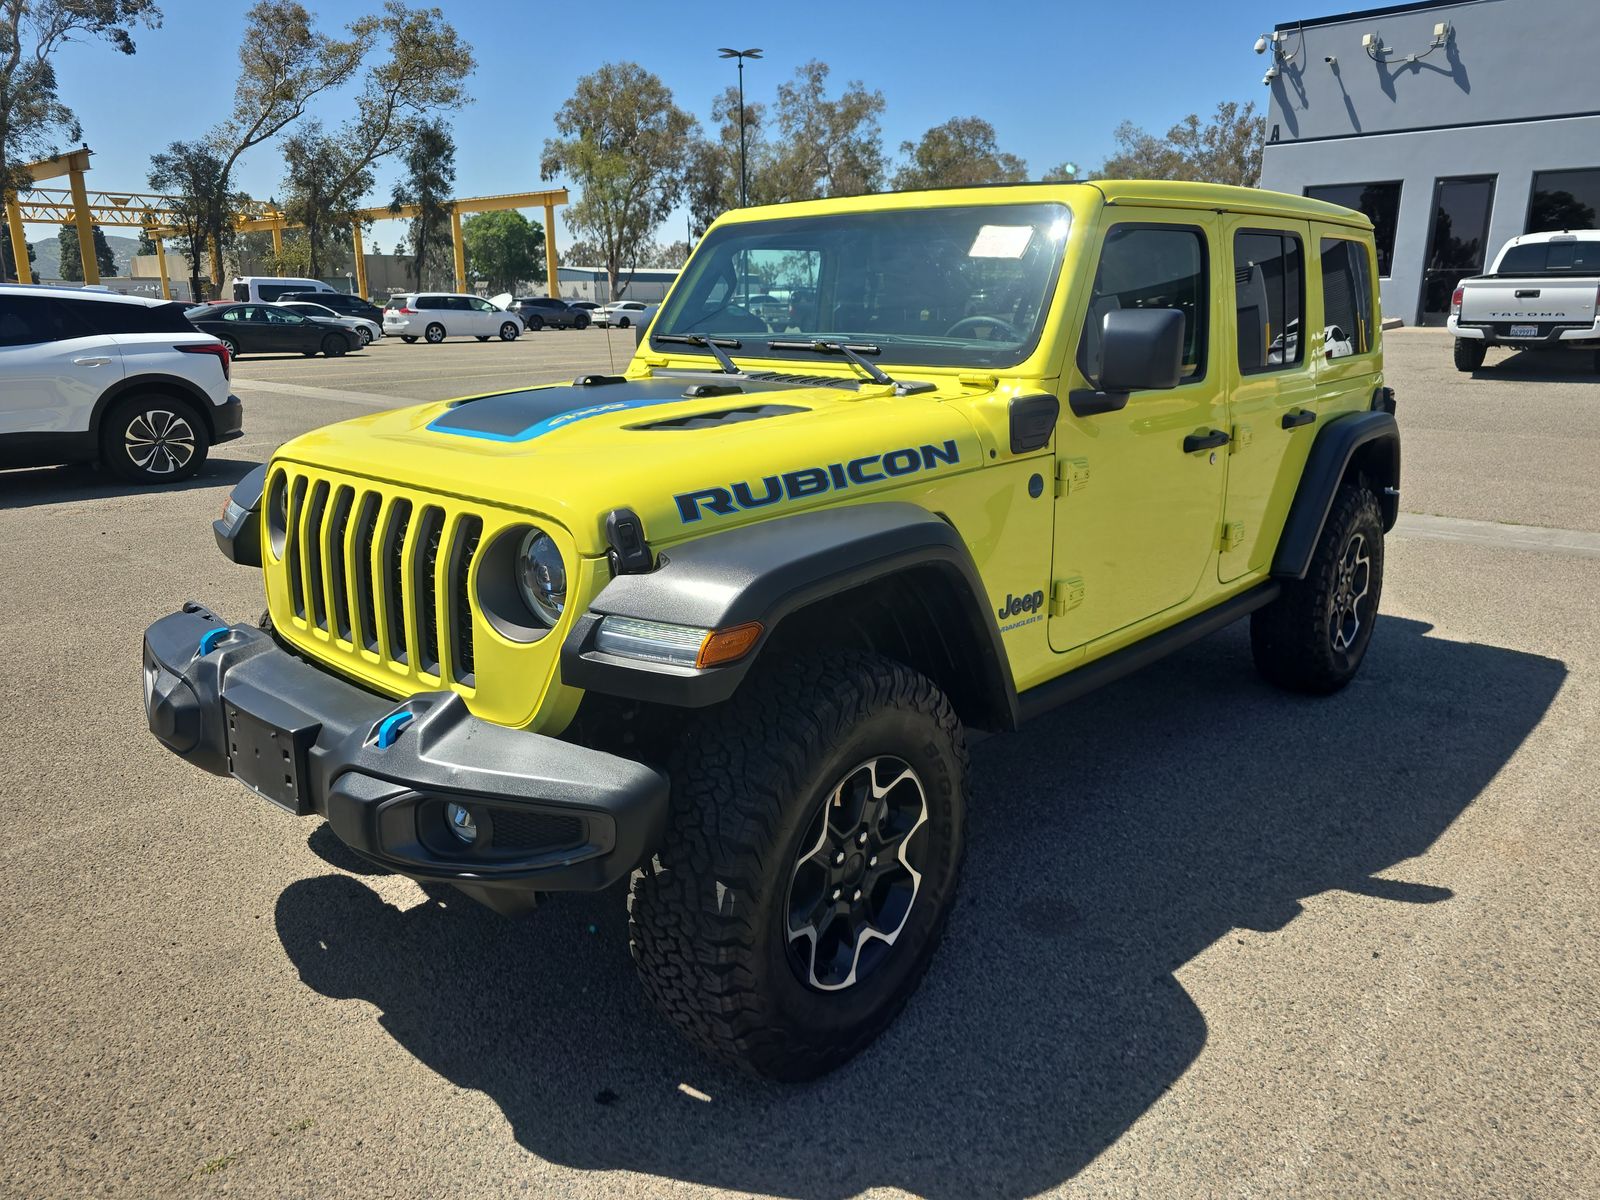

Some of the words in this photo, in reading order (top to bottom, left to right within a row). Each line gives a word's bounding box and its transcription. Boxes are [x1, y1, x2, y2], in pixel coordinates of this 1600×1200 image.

[1270, 124, 1280, 141] A
[672, 439, 961, 524] RUBICON
[998, 590, 1044, 620] Jeep
